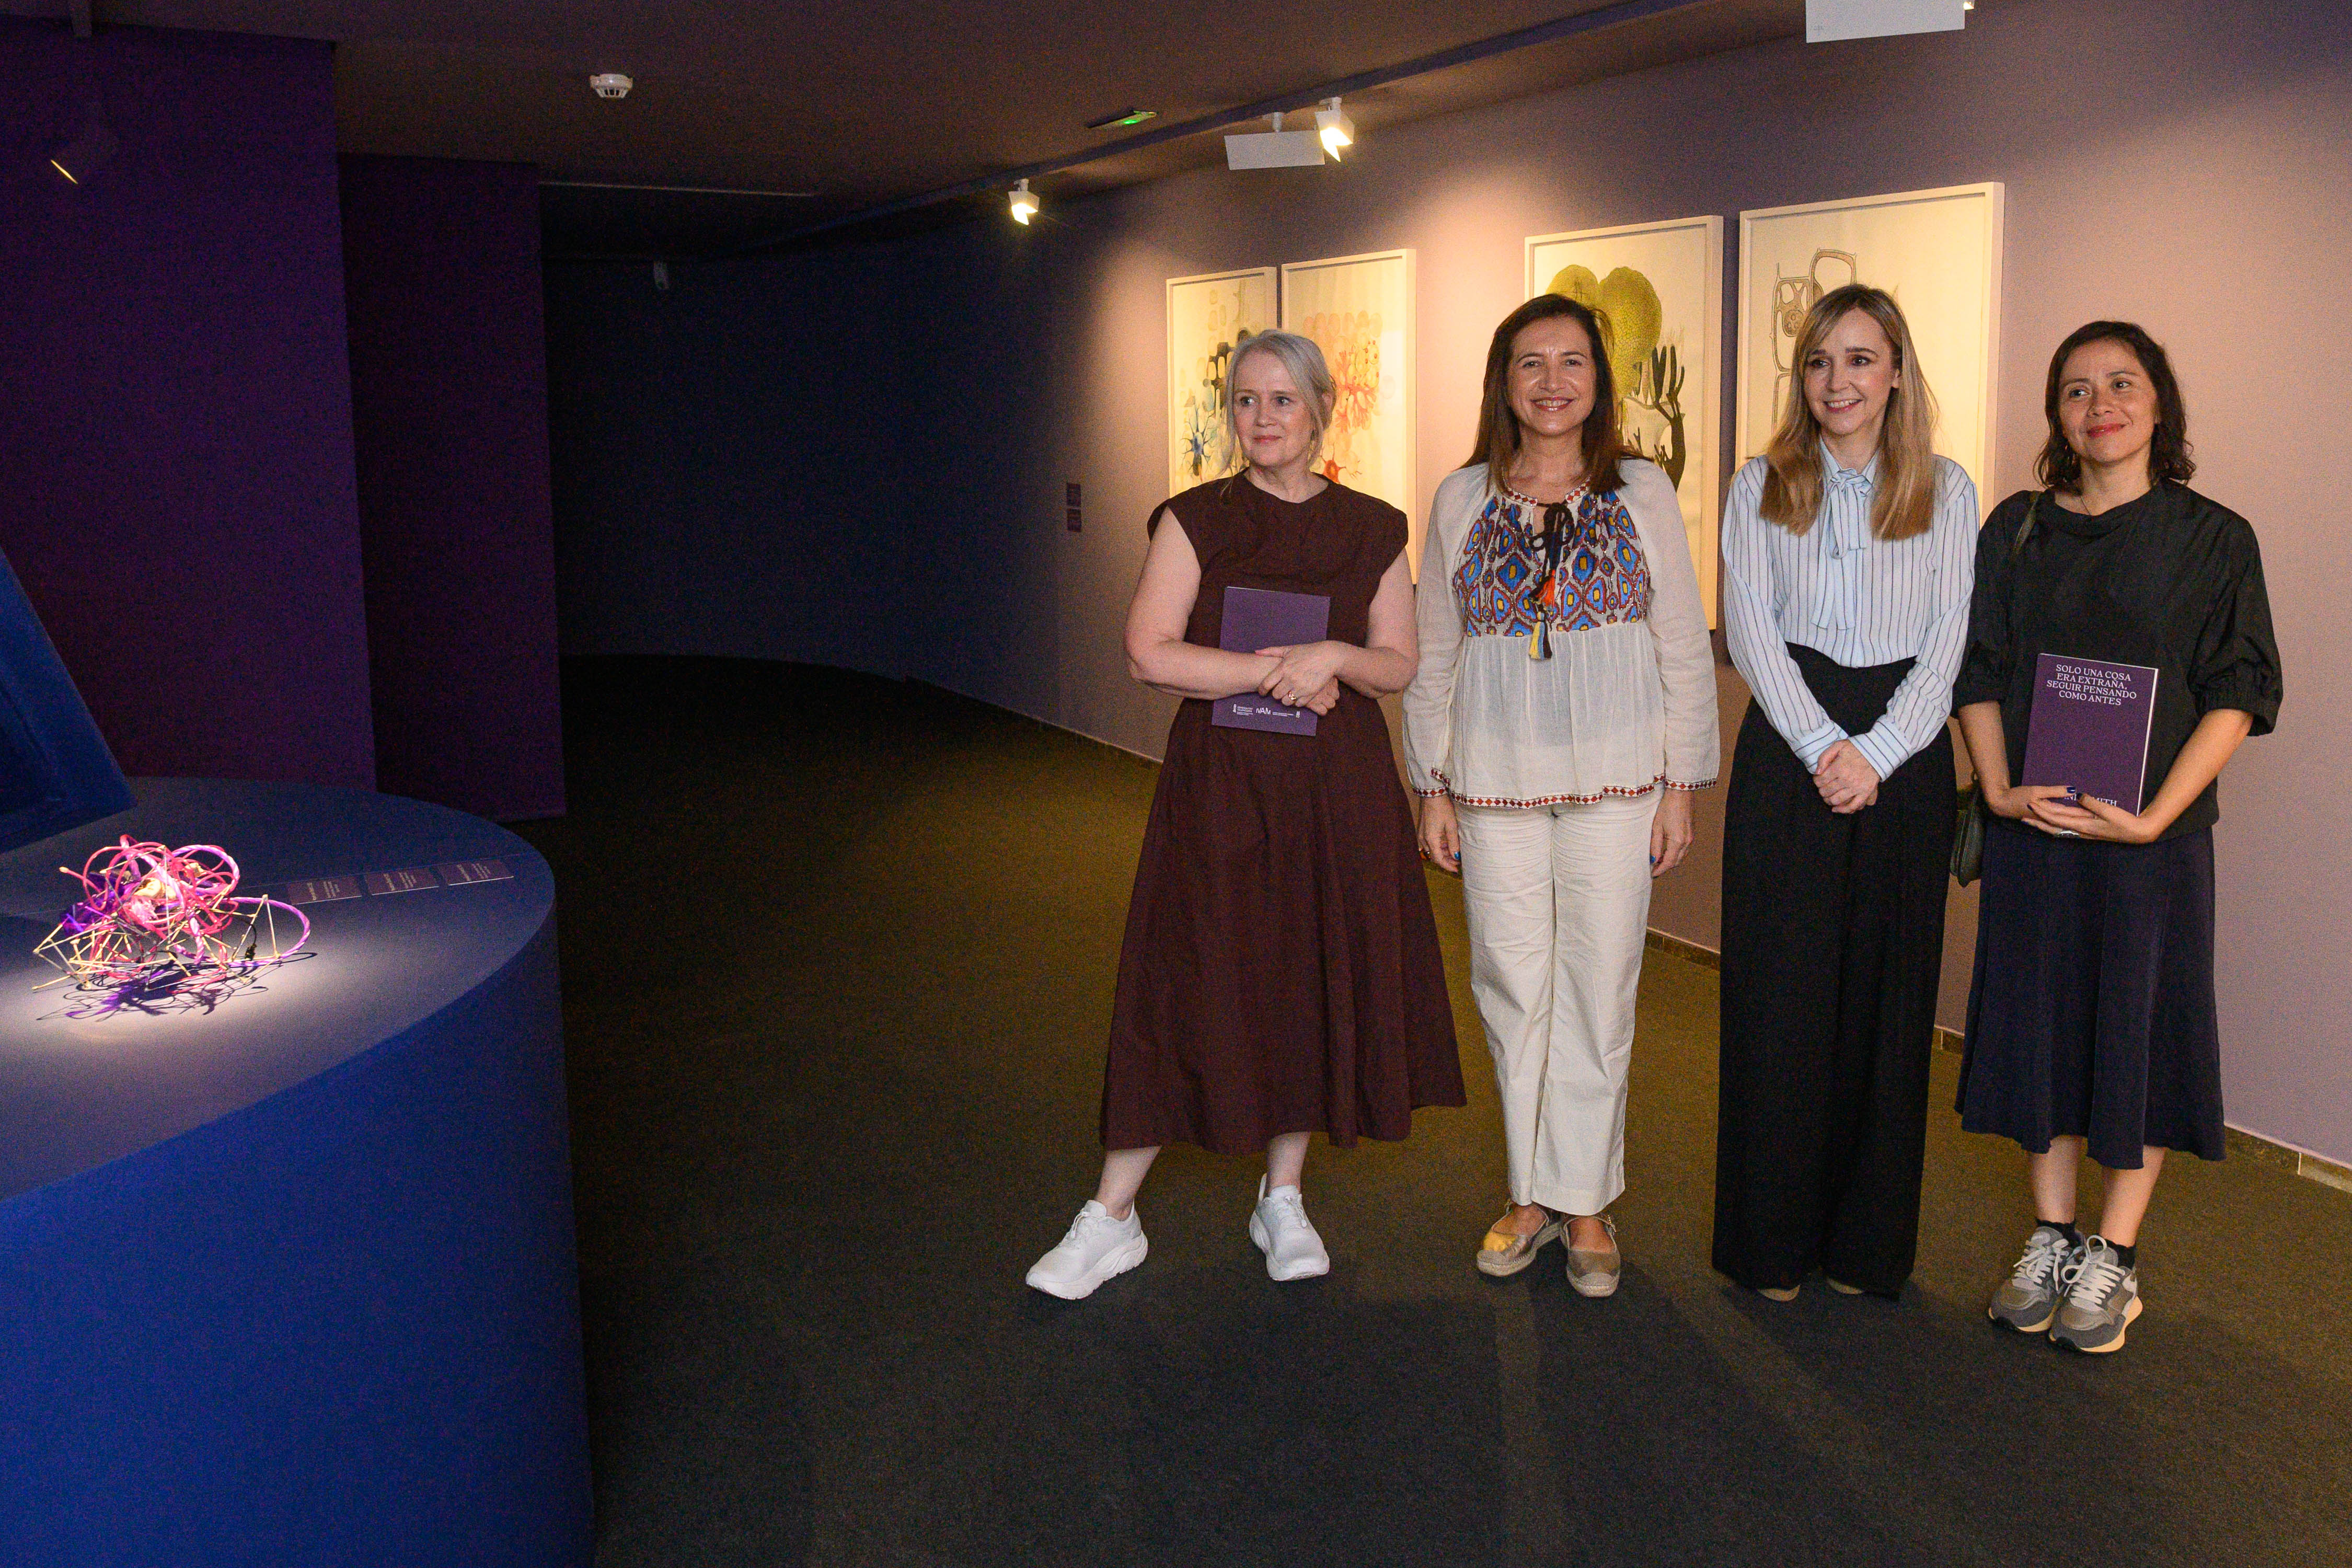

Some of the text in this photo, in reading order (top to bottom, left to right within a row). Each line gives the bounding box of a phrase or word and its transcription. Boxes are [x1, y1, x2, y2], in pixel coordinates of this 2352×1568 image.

[2056, 664, 2131, 681] SOLO UNA COSA
[2046, 680, 2137, 699] SEGUIR PENSANDO
[2057, 673, 2127, 690] ERA EXTRAÑA,
[2059, 690, 2122, 706] COMO ANTES
